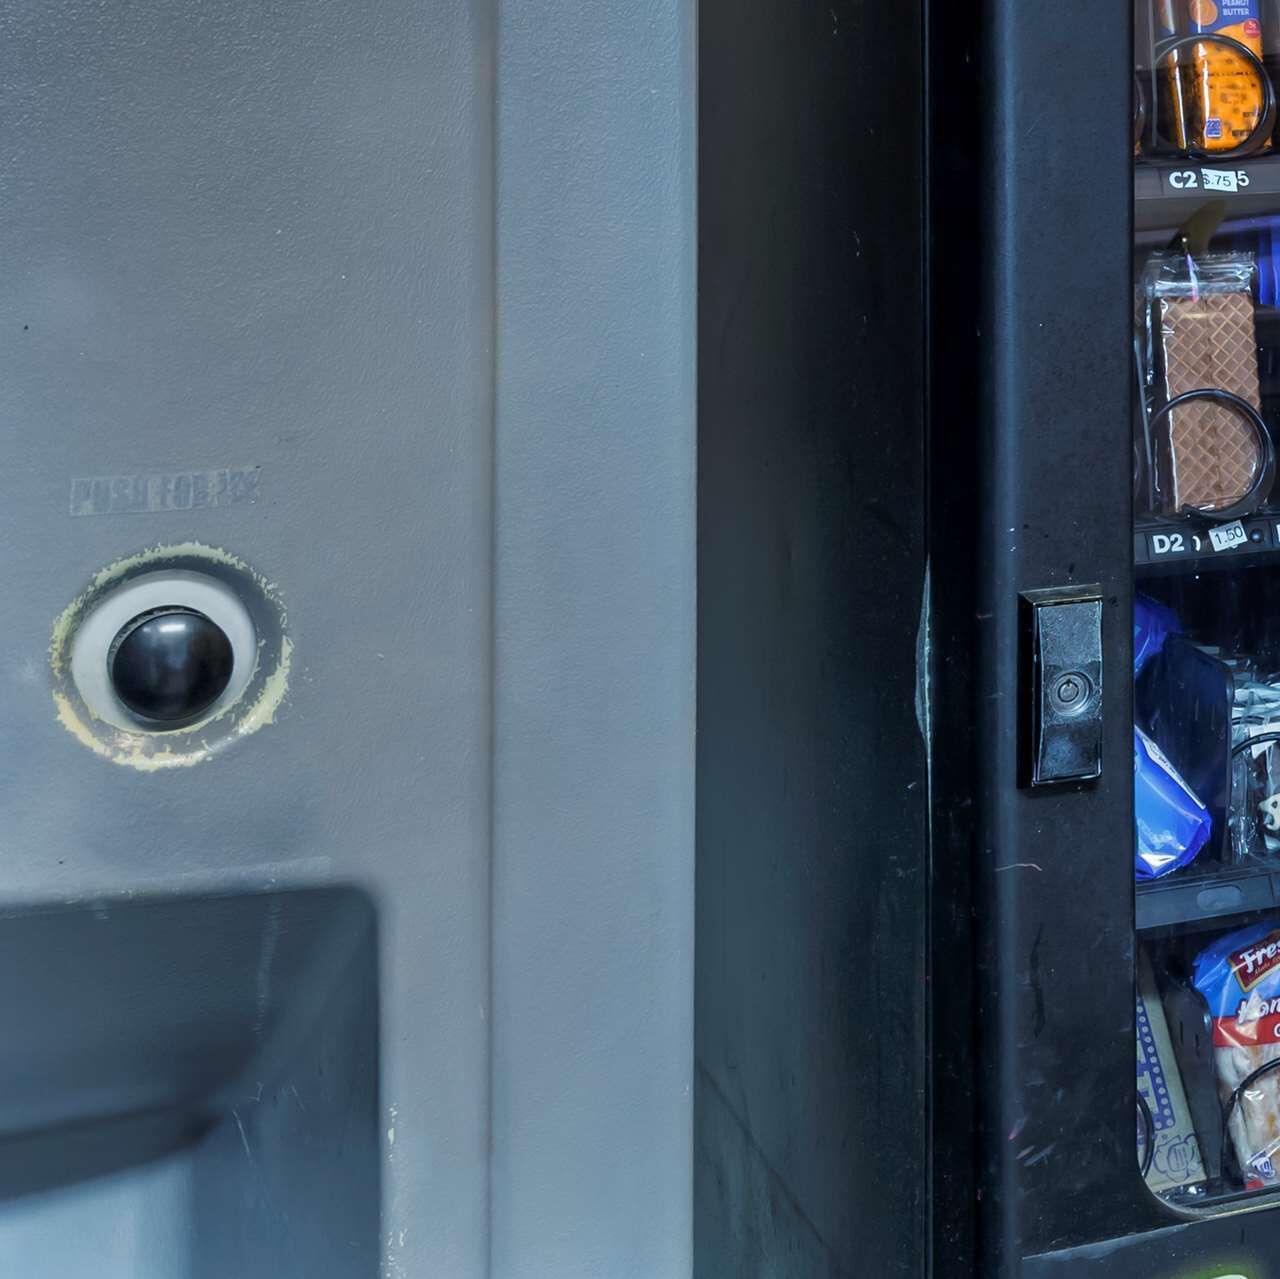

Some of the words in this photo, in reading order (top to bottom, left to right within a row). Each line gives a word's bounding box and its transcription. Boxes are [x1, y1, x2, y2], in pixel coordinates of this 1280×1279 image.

[1222, 8, 1250, 16] BUTTER
[1169, 171, 1198, 189] C2
[1153, 534, 1184, 552] D2
[1214, 527, 1244, 545] 1.50
